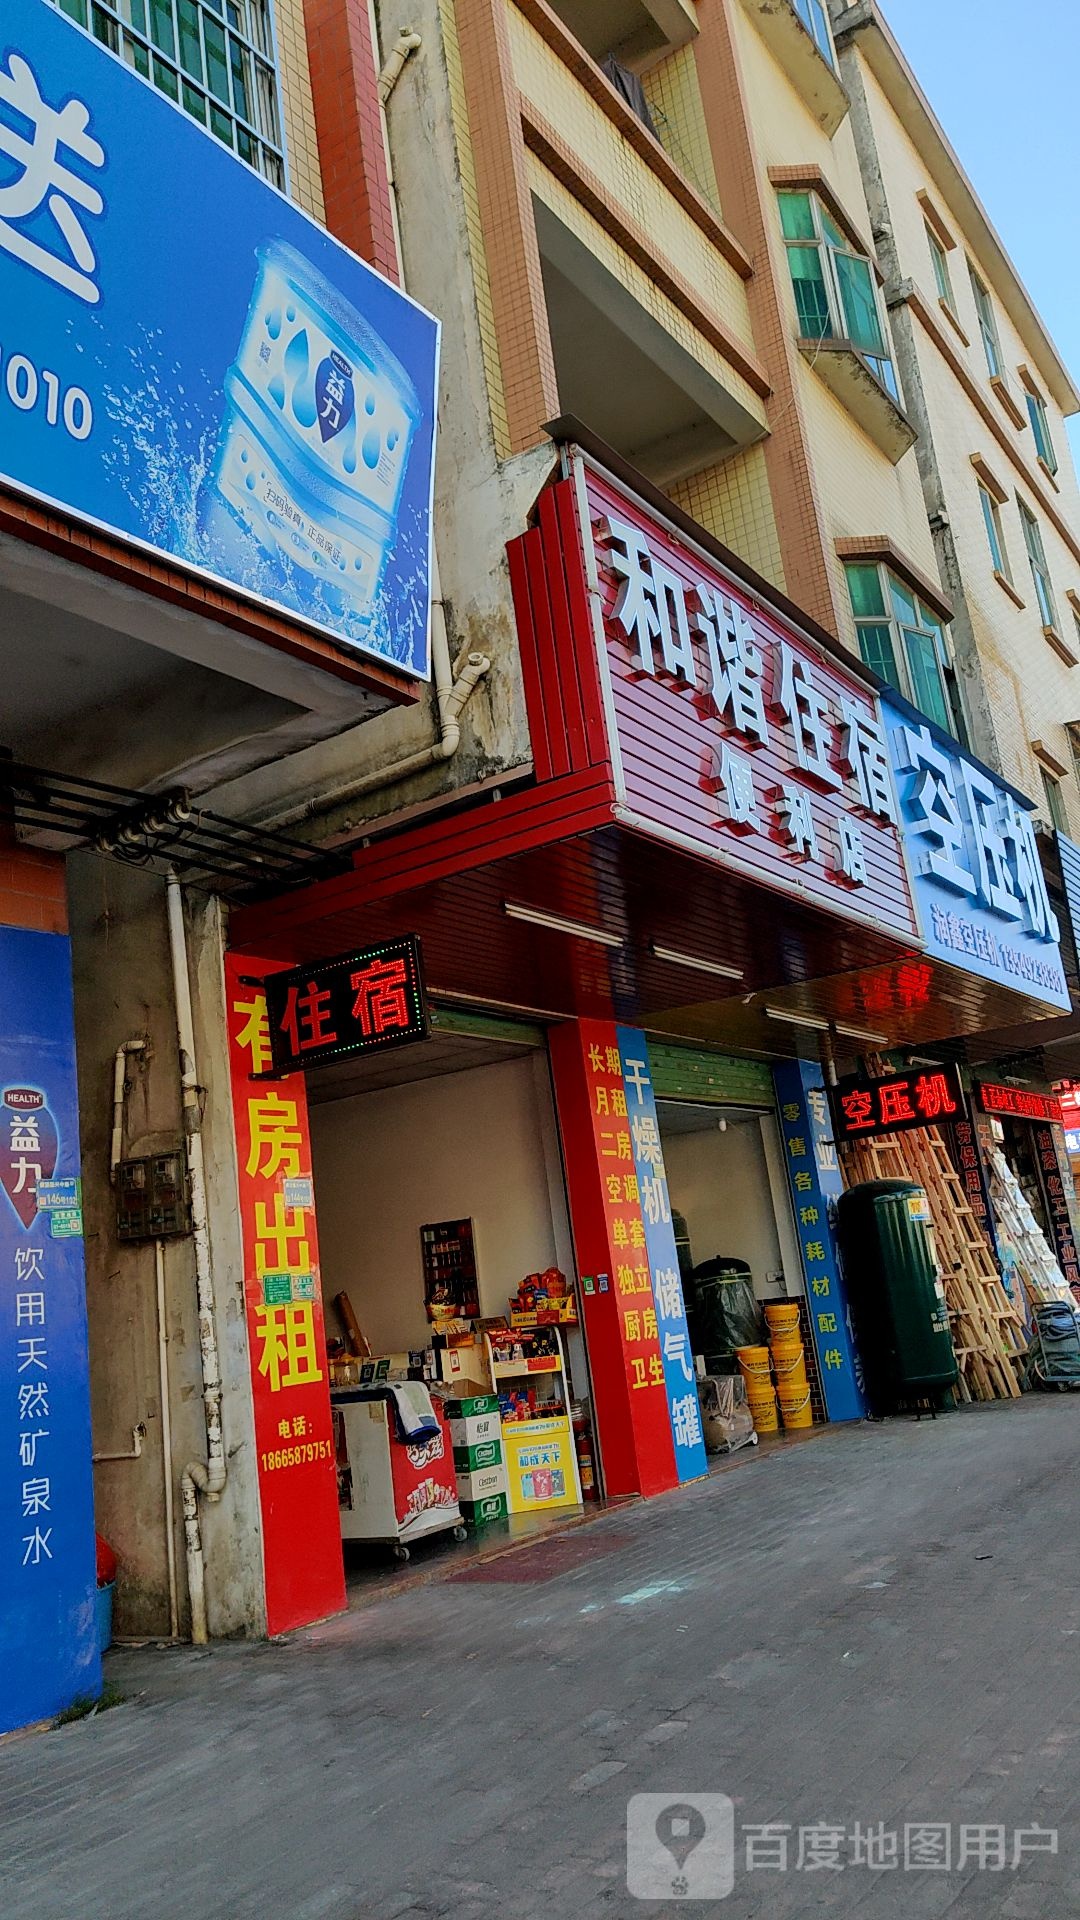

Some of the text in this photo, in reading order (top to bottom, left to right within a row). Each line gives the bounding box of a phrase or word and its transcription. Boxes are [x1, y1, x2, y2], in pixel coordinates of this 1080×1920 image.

[0, 346, 93, 440] 010
[320, 369, 347, 430] 益力
[607, 514, 898, 828] 和谐住宿
[720, 741, 869, 888] 便利店
[903, 724, 1061, 943] 空压机
[280, 959, 408, 1057] 住宿
[588, 1043, 622, 1077] 长期
[7, 1092, 41, 1104] HEALTH
[595, 1086, 628, 1118] 月租
[842, 1074, 956, 1130] 空压机
[10, 1115, 42, 1194] 益力
[600, 1131, 632, 1162] 二房
[233, 994, 322, 1393] 有房出租
[608, 1174, 640, 1205] 空调
[613, 1218, 646, 1251] 单套
[624, 1057, 703, 1450] 干燥机 储气罐
[783, 1102, 844, 1371] 零售各种耗材配件
[618, 1262, 651, 1297] 独立
[624, 1308, 659, 1343] 厨房
[632, 1357, 665, 1390] 卫生
[13, 1245, 53, 1567] 饮用天然矿泉水
[261, 1438, 332, 1472] 18665879751
